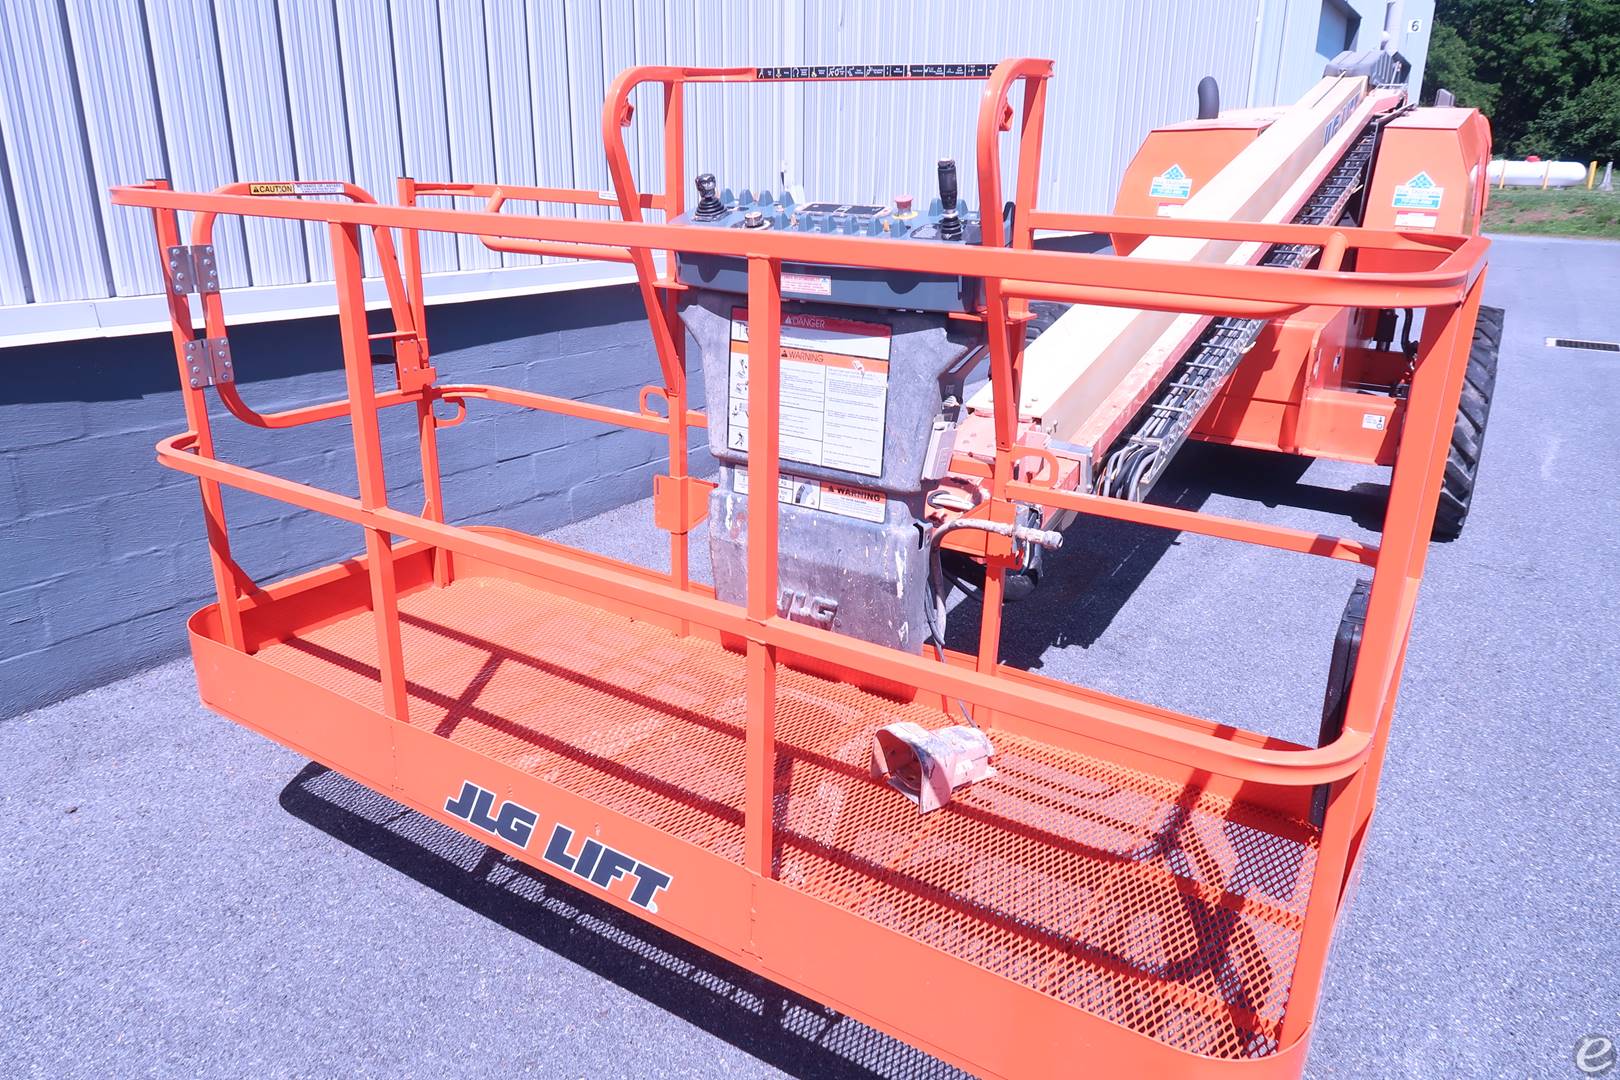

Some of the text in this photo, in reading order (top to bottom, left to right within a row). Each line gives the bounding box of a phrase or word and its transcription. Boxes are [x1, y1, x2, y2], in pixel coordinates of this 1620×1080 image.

[1411, 20, 1420, 32] 6
[259, 184, 293, 193] CAUTION
[791, 317, 826, 329] DANGER
[788, 350, 824, 363] WARNING
[837, 487, 881, 502] WARNING
[443, 779, 674, 909] JLG LIFT
